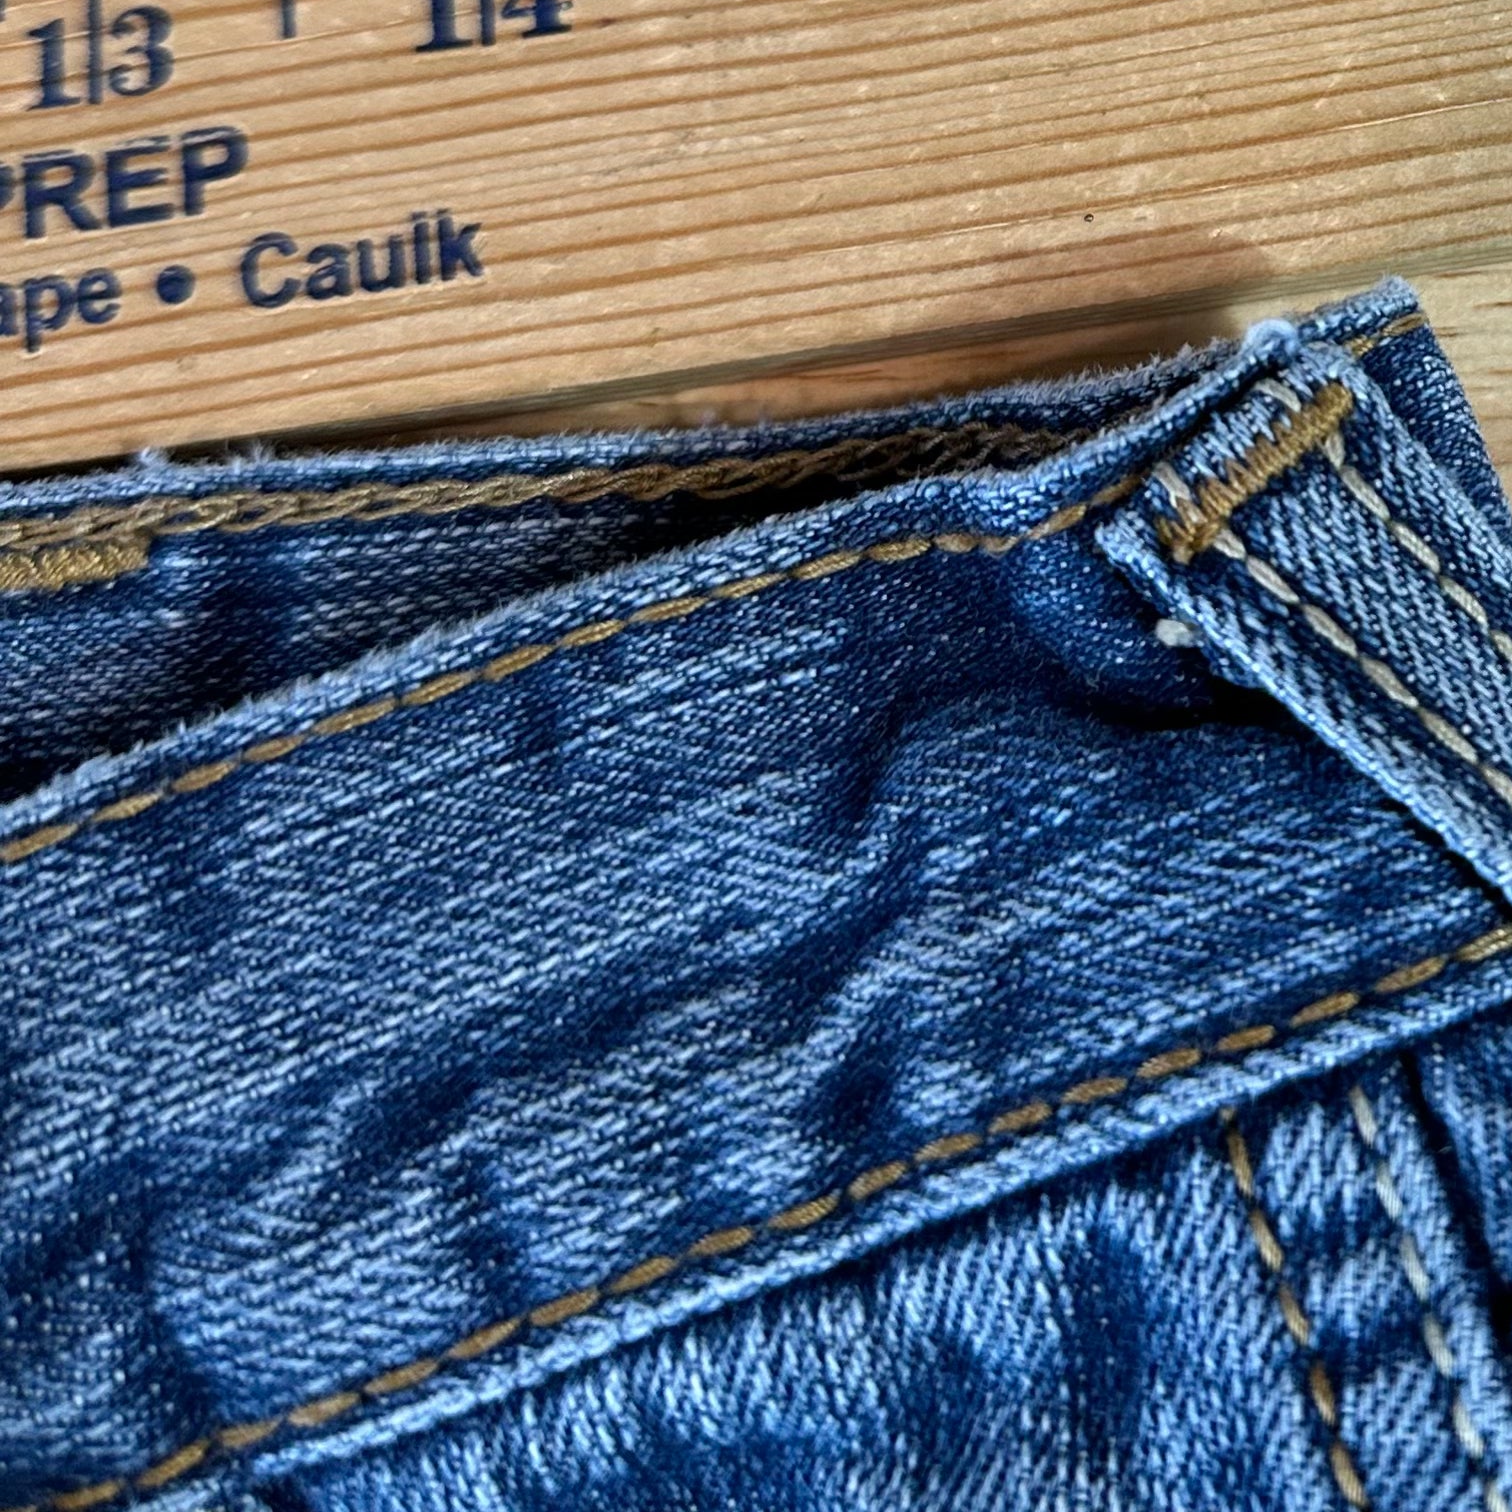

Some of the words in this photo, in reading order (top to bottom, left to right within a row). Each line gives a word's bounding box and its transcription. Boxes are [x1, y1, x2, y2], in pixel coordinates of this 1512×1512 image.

[27, 5, 175, 111] 13
[0, 125, 250, 239] REP
[239, 208, 484, 308] Caulk
